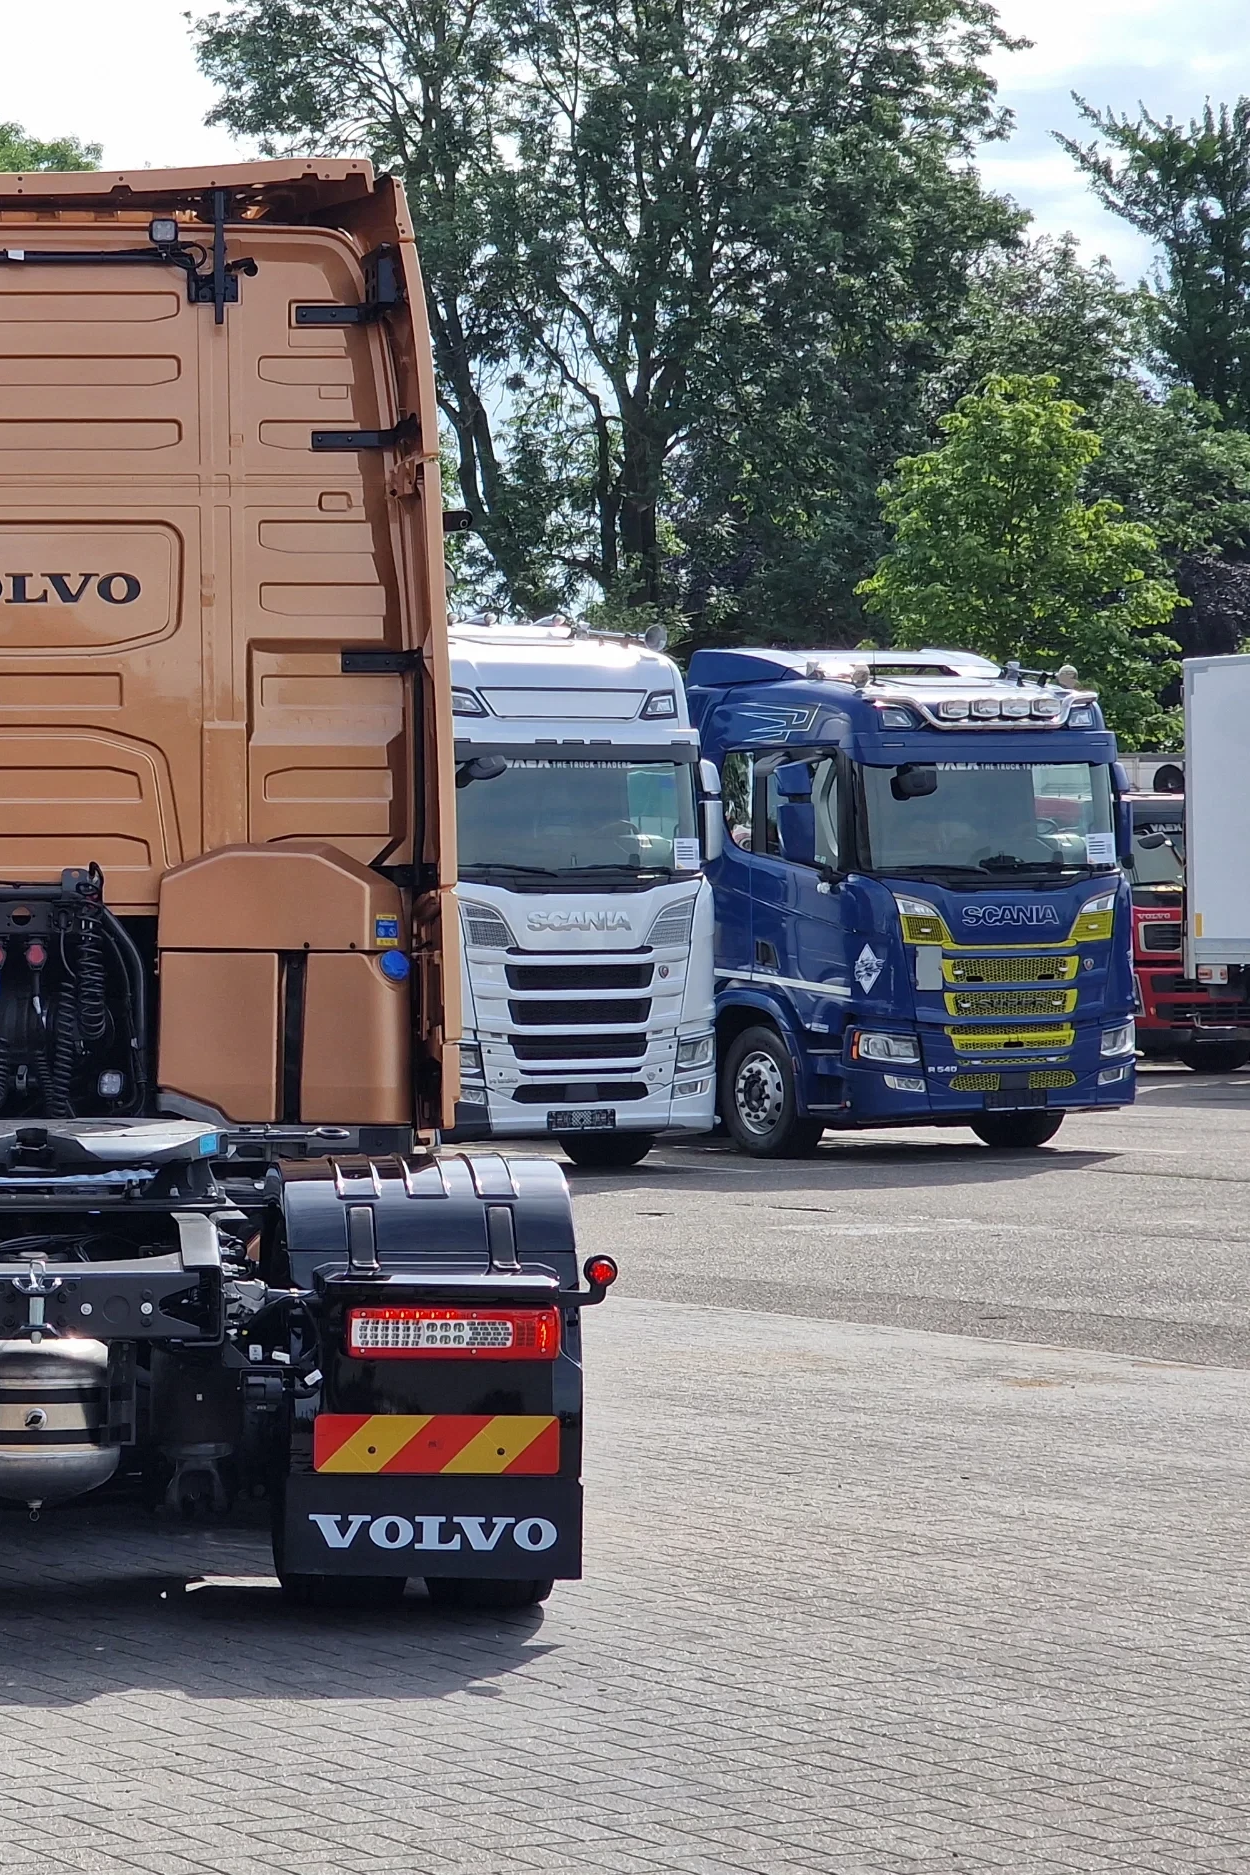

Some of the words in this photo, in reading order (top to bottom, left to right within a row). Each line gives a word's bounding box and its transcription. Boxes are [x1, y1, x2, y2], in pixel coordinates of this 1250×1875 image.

[552, 761, 567, 769] THE
[569, 761, 595, 769] TRUCK
[980, 763, 995, 771] THE
[996, 763, 1021, 771] TRUCK
[527, 911, 633, 931] SCANIA
[962, 905, 1060, 926] SCANIA
[308, 1513, 558, 1551] VOLVO
